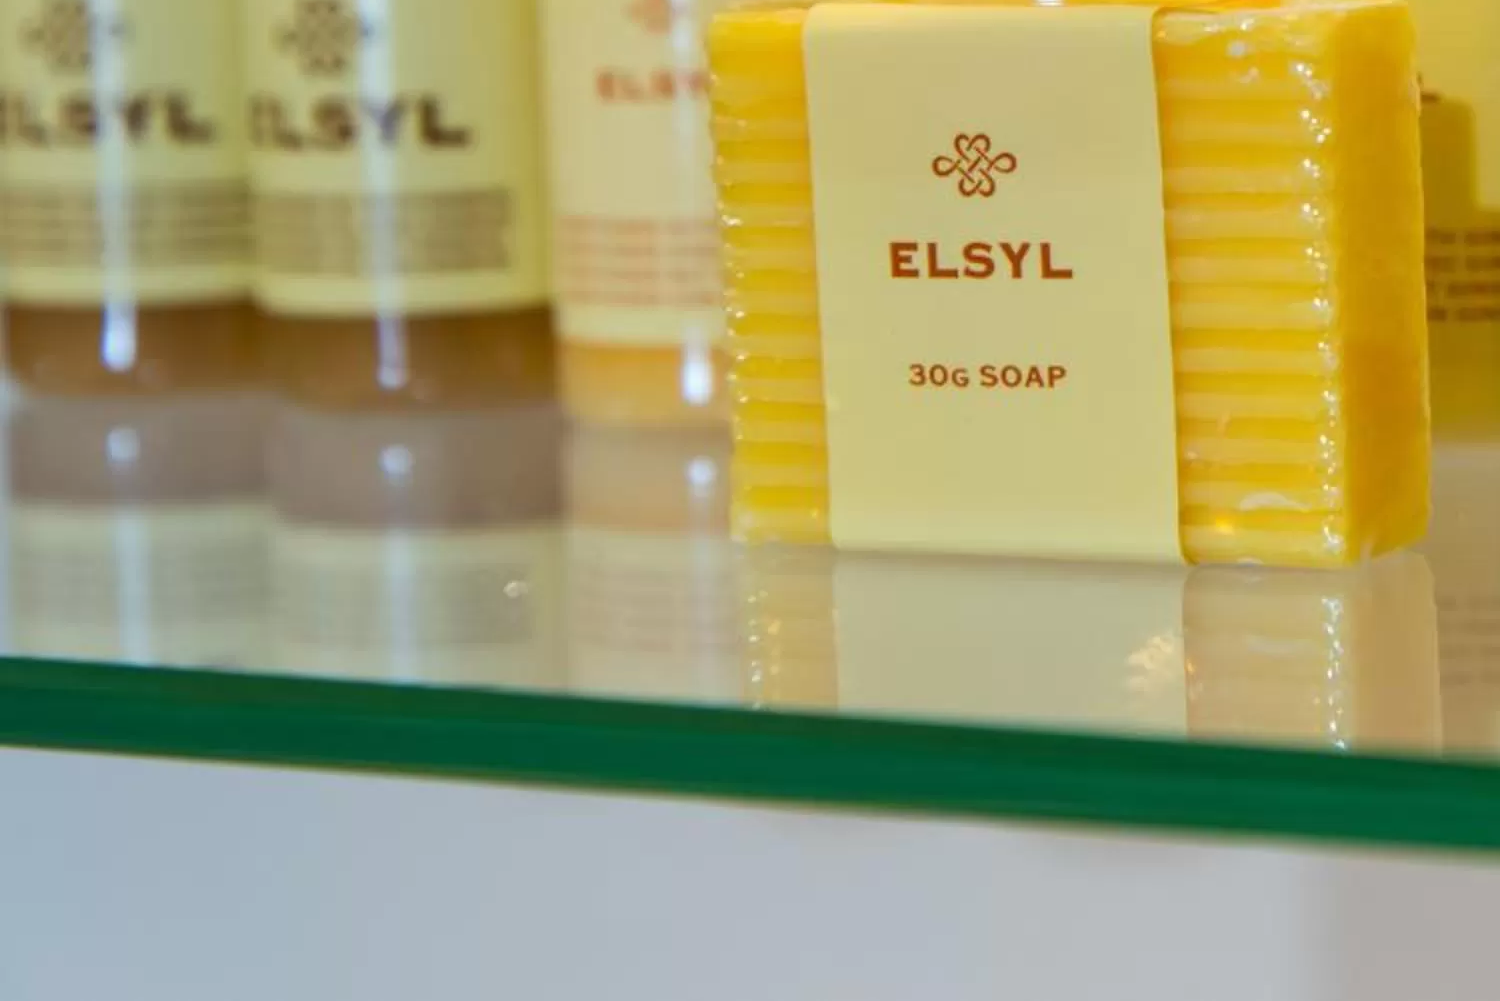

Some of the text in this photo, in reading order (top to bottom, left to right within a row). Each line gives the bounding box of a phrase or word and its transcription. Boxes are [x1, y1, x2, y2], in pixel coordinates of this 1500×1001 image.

[597, 69, 710, 103] ELSY
[0, 93, 214, 147] LSYL
[889, 242, 1073, 279] ELSYL
[979, 363, 1067, 388] SOAP
